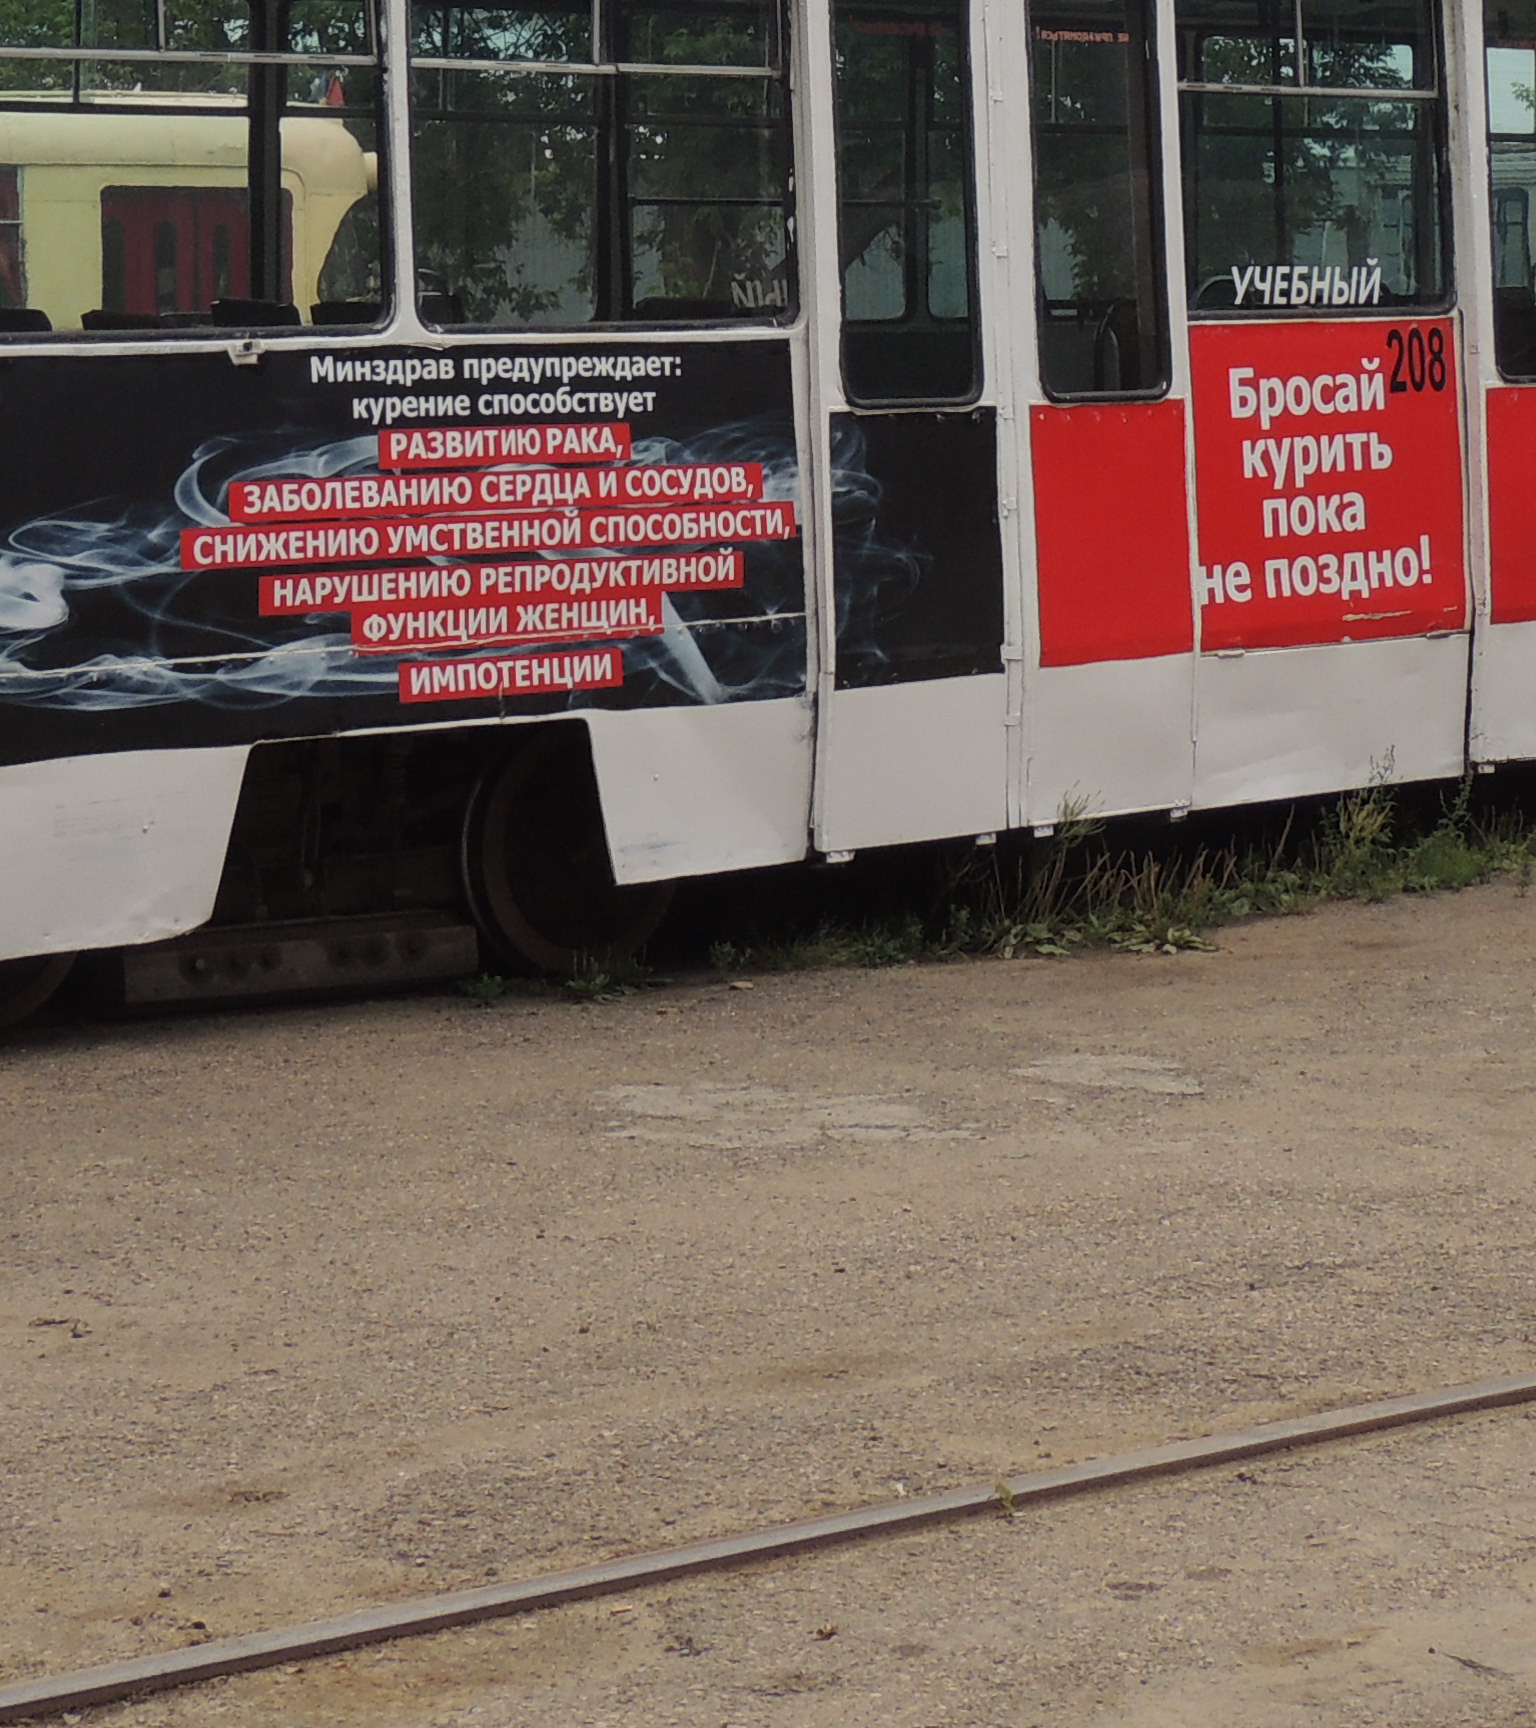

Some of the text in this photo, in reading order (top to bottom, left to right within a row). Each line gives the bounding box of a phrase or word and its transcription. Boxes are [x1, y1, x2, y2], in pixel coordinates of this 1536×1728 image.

[1232, 258, 1382, 305] УЧЕБНЫЙ
[311, 356, 682, 386] Минздрав предупреждает:
[1386, 327, 1446, 393] 208
[352, 386, 657, 425] курение способствует
[1228, 357, 1385, 429] Бросай
[390, 426, 624, 460] РАЗВИТИЮ РАКА,
[1243, 432, 1393, 489] курить
[243, 466, 754, 514] ЗАБОЛЕВАНИЮ СЕРДЦА И СОСУДОВ,
[193, 508, 790, 565] СНИЖЕНИЮ УМСТВЕННОЙ СПОСОБНОСТИ,
[1263, 491, 1365, 538] пока
[273, 546, 735, 607] НАРУШЕНИЮ РЕПРОДУКТИВНОЙ
[1198, 535, 1433, 604] не поздно!
[363, 597, 656, 642] ФУНКЦИИ ЖЕНЩИН,
[410, 654, 612, 695] ИМПОТЕНЦИИ
